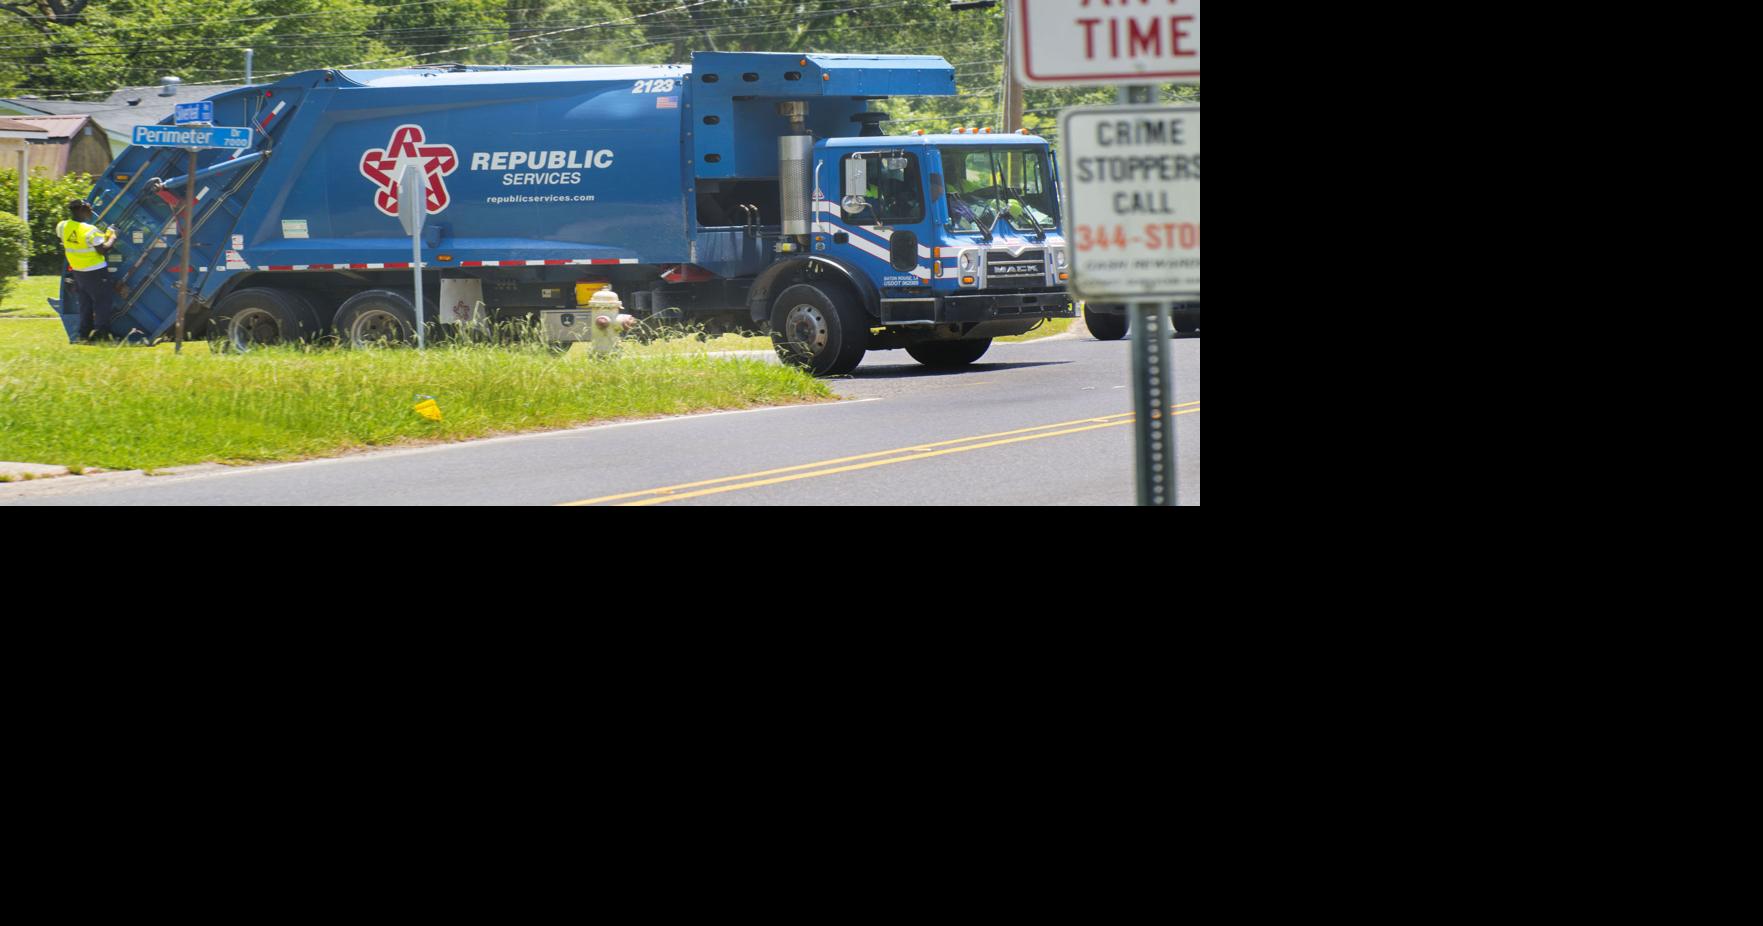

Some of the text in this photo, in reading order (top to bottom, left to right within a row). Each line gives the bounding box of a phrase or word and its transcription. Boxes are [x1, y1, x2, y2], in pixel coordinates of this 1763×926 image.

[1076, 15, 1197, 59] TIME
[136, 127, 213, 144] Perimeter
[1097, 119, 1184, 146] CRIME
[470, 149, 614, 171] REPUBLIC
[502, 172, 581, 185] SERVICES
[487, 194, 595, 204] republicservices.com
[1113, 191, 1174, 214] CALL
[1076, 222, 1199, 251] 344-STO
[994, 265, 1039, 273] MACK
